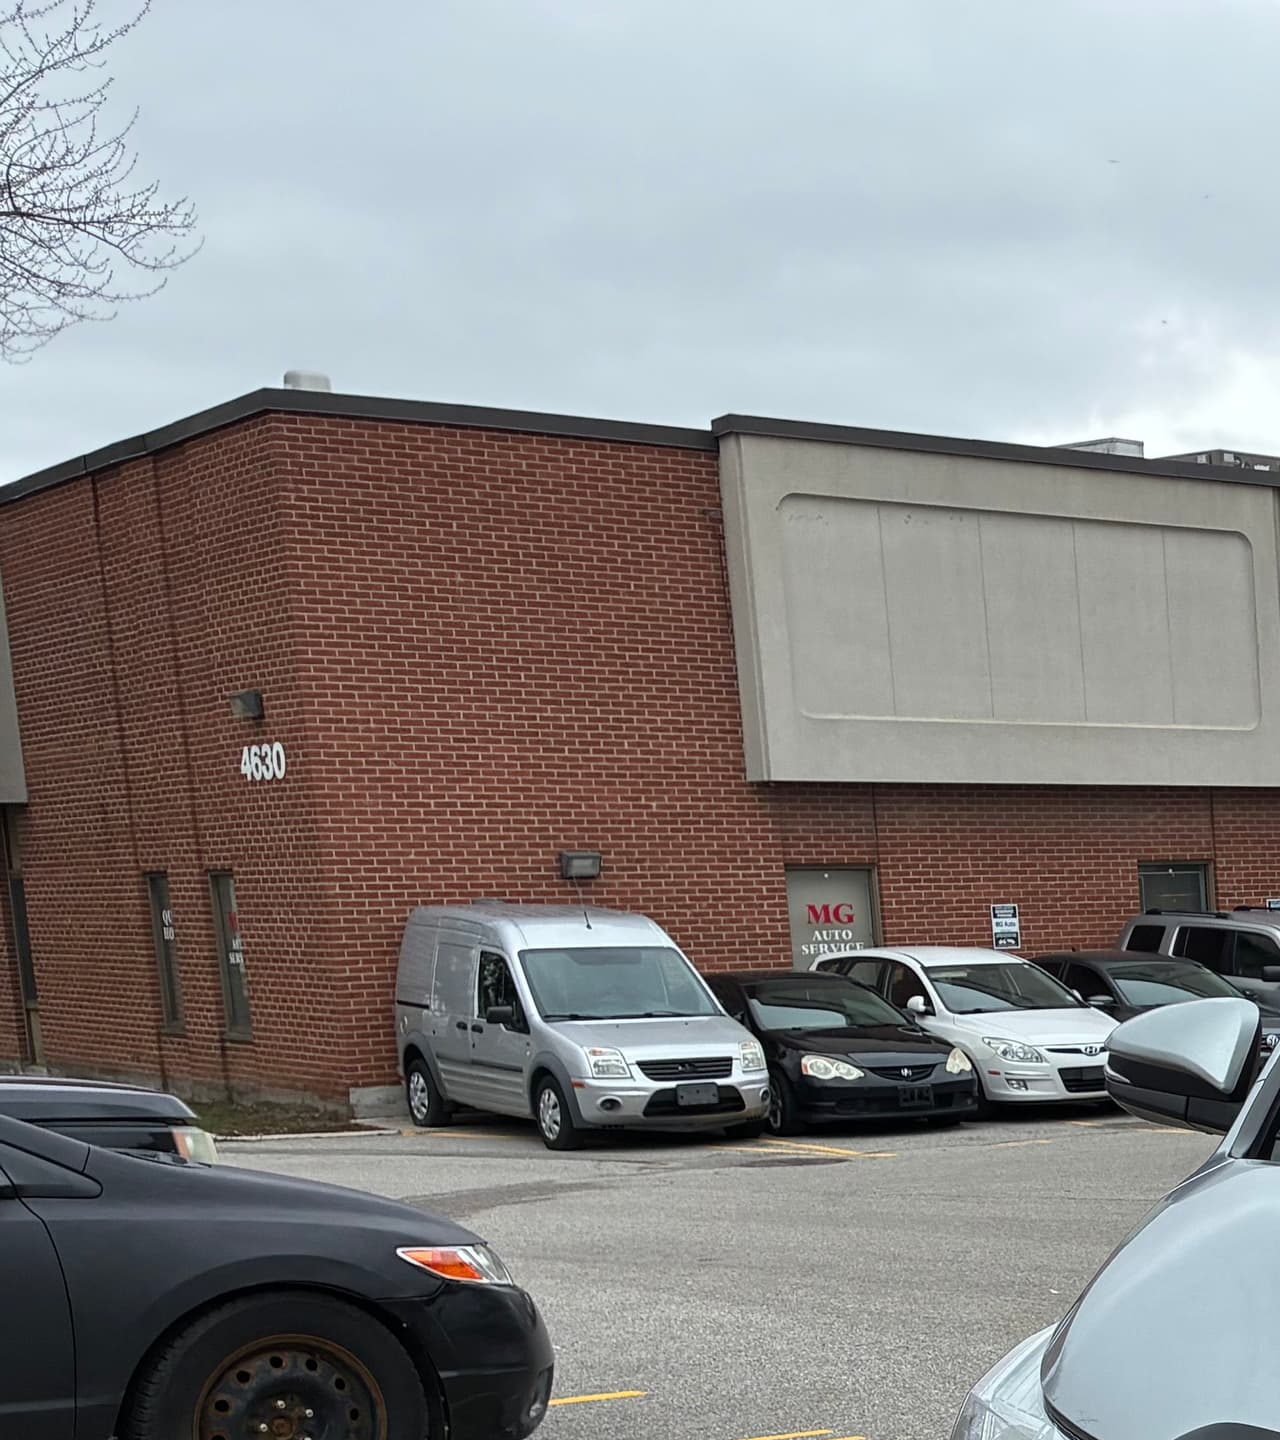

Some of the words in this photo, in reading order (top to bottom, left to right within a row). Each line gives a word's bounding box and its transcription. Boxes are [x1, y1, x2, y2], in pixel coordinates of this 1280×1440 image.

[241, 741, 286, 781] 4630
[806, 903, 855, 925] MG
[812, 929, 853, 941] AUTO
[801, 942, 865, 956] SERVICE
